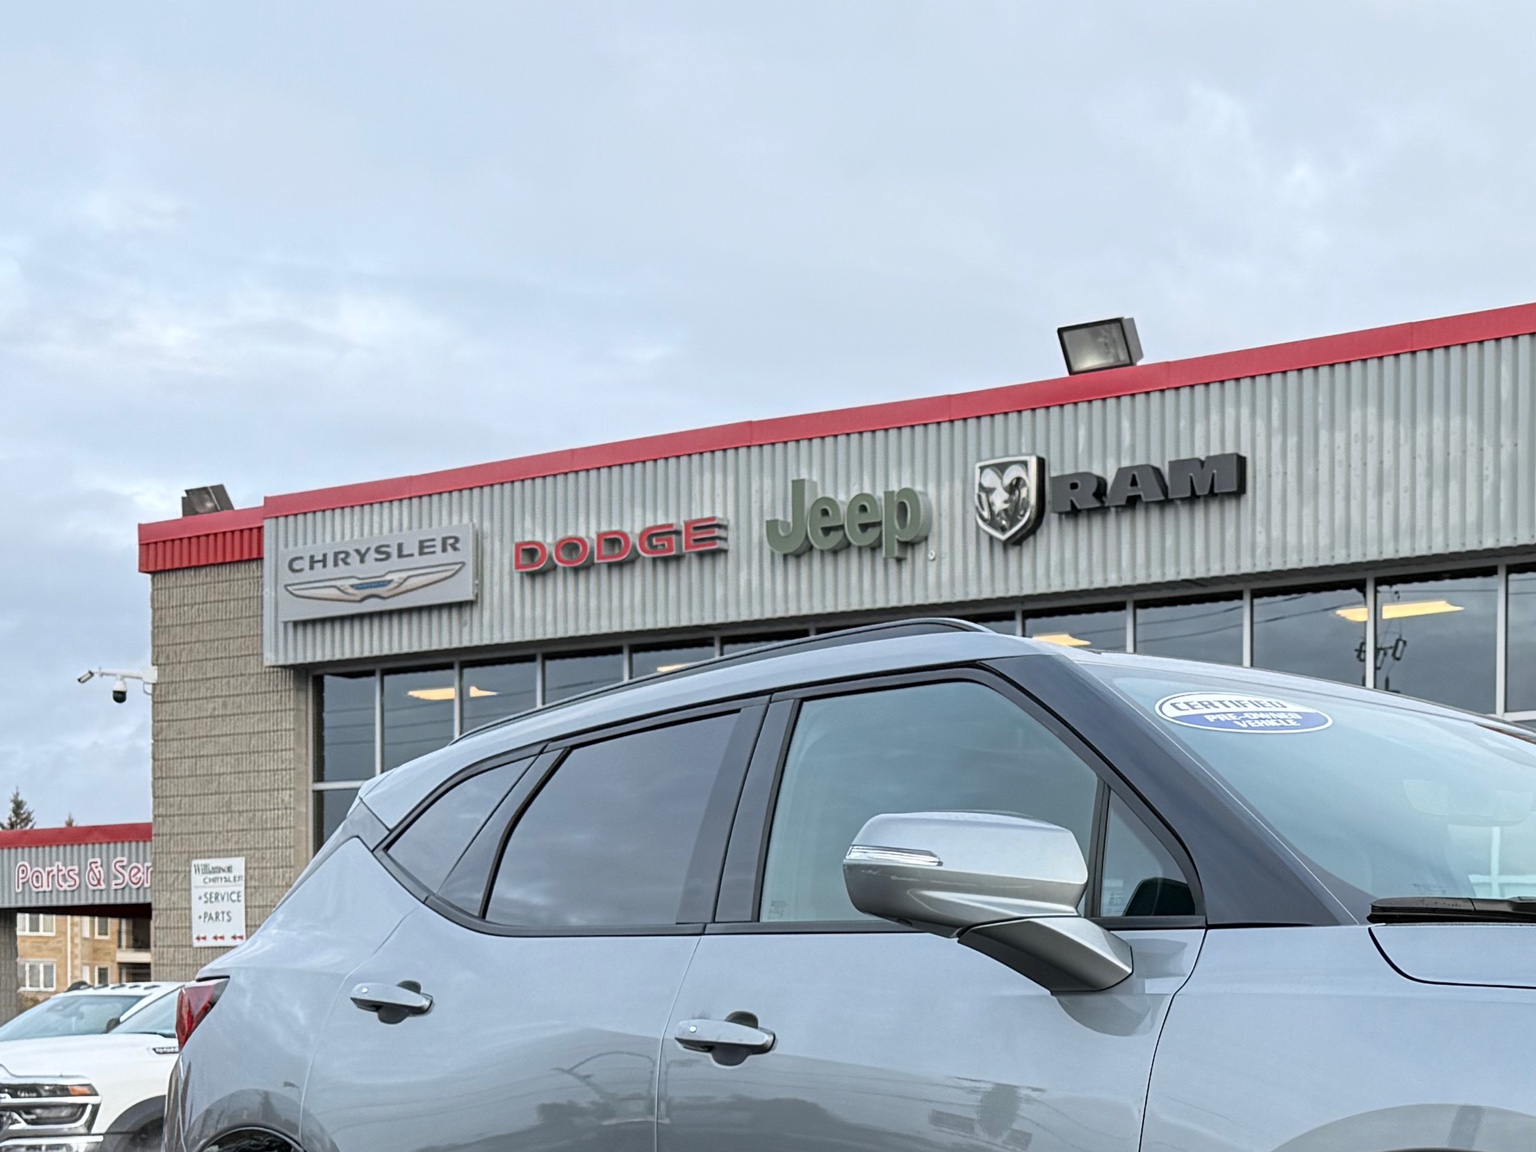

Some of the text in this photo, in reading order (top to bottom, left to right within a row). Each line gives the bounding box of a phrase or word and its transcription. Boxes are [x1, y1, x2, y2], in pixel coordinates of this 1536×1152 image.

[1050, 452, 1246, 516] RAM
[766, 478, 931, 561] Jeep
[287, 535, 461, 574] CHRYSLER
[514, 516, 726, 574] DODGE
[1170, 698, 1288, 713] CERTIFIED
[15, 861, 79, 893] Parts
[85, 857, 106, 890] &
[203, 890, 242, 905] SERVICE
[203, 910, 232, 924] PARTS
